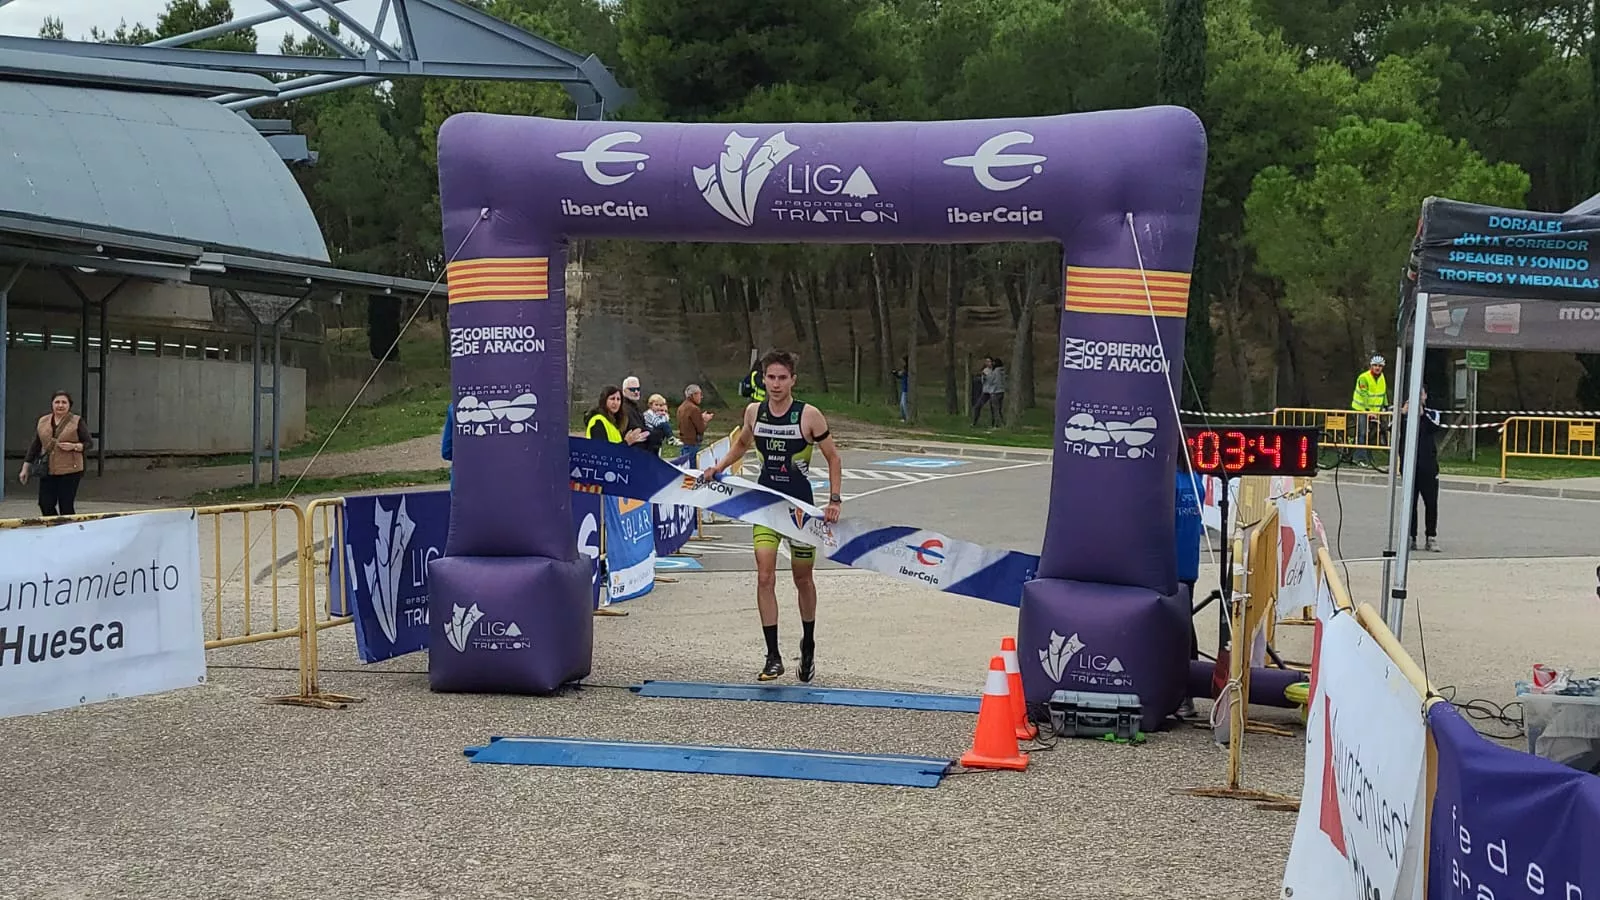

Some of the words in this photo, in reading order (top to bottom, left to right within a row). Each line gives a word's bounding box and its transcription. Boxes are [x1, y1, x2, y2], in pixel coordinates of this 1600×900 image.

[787, 163, 879, 199] LIGA
[562, 199, 649, 221] iberCaja
[771, 208, 898, 223] TRIATLON
[947, 206, 1043, 225] iberCaja
[1488, 215, 1562, 233] DORSALES
[1505, 237, 1589, 251] CORREDOR
[1449, 250, 1514, 266] SPEAKER
[1517, 256, 1528, 267] Y
[1531, 256, 1589, 271] SONIDO
[1438, 268, 1503, 284] TROFEOS
[1506, 273, 1517, 285] Y
[1520, 274, 1599, 289] MEDALLAS
[463, 325, 535, 341] GOBIERNO
[464, 341, 479, 355] DE
[483, 339, 545, 354] ARAGON
[1085, 341, 1163, 358] GOBIERNO
[1083, 357, 1103, 370] DE
[1107, 357, 1170, 373] ARAGON
[456, 421, 538, 436] TRIATLON
[1063, 440, 1155, 459] TRIATLON
[620, 509, 652, 541] SOLAR
[898, 565, 940, 585] iberCaja
[479, 621, 523, 637] LIGA
[0, 620, 124, 667] Huesca
[472, 641, 531, 650] TRIATLON
[1079, 653, 1125, 673] LIGA
[1069, 673, 1132, 686] TRIATLON
